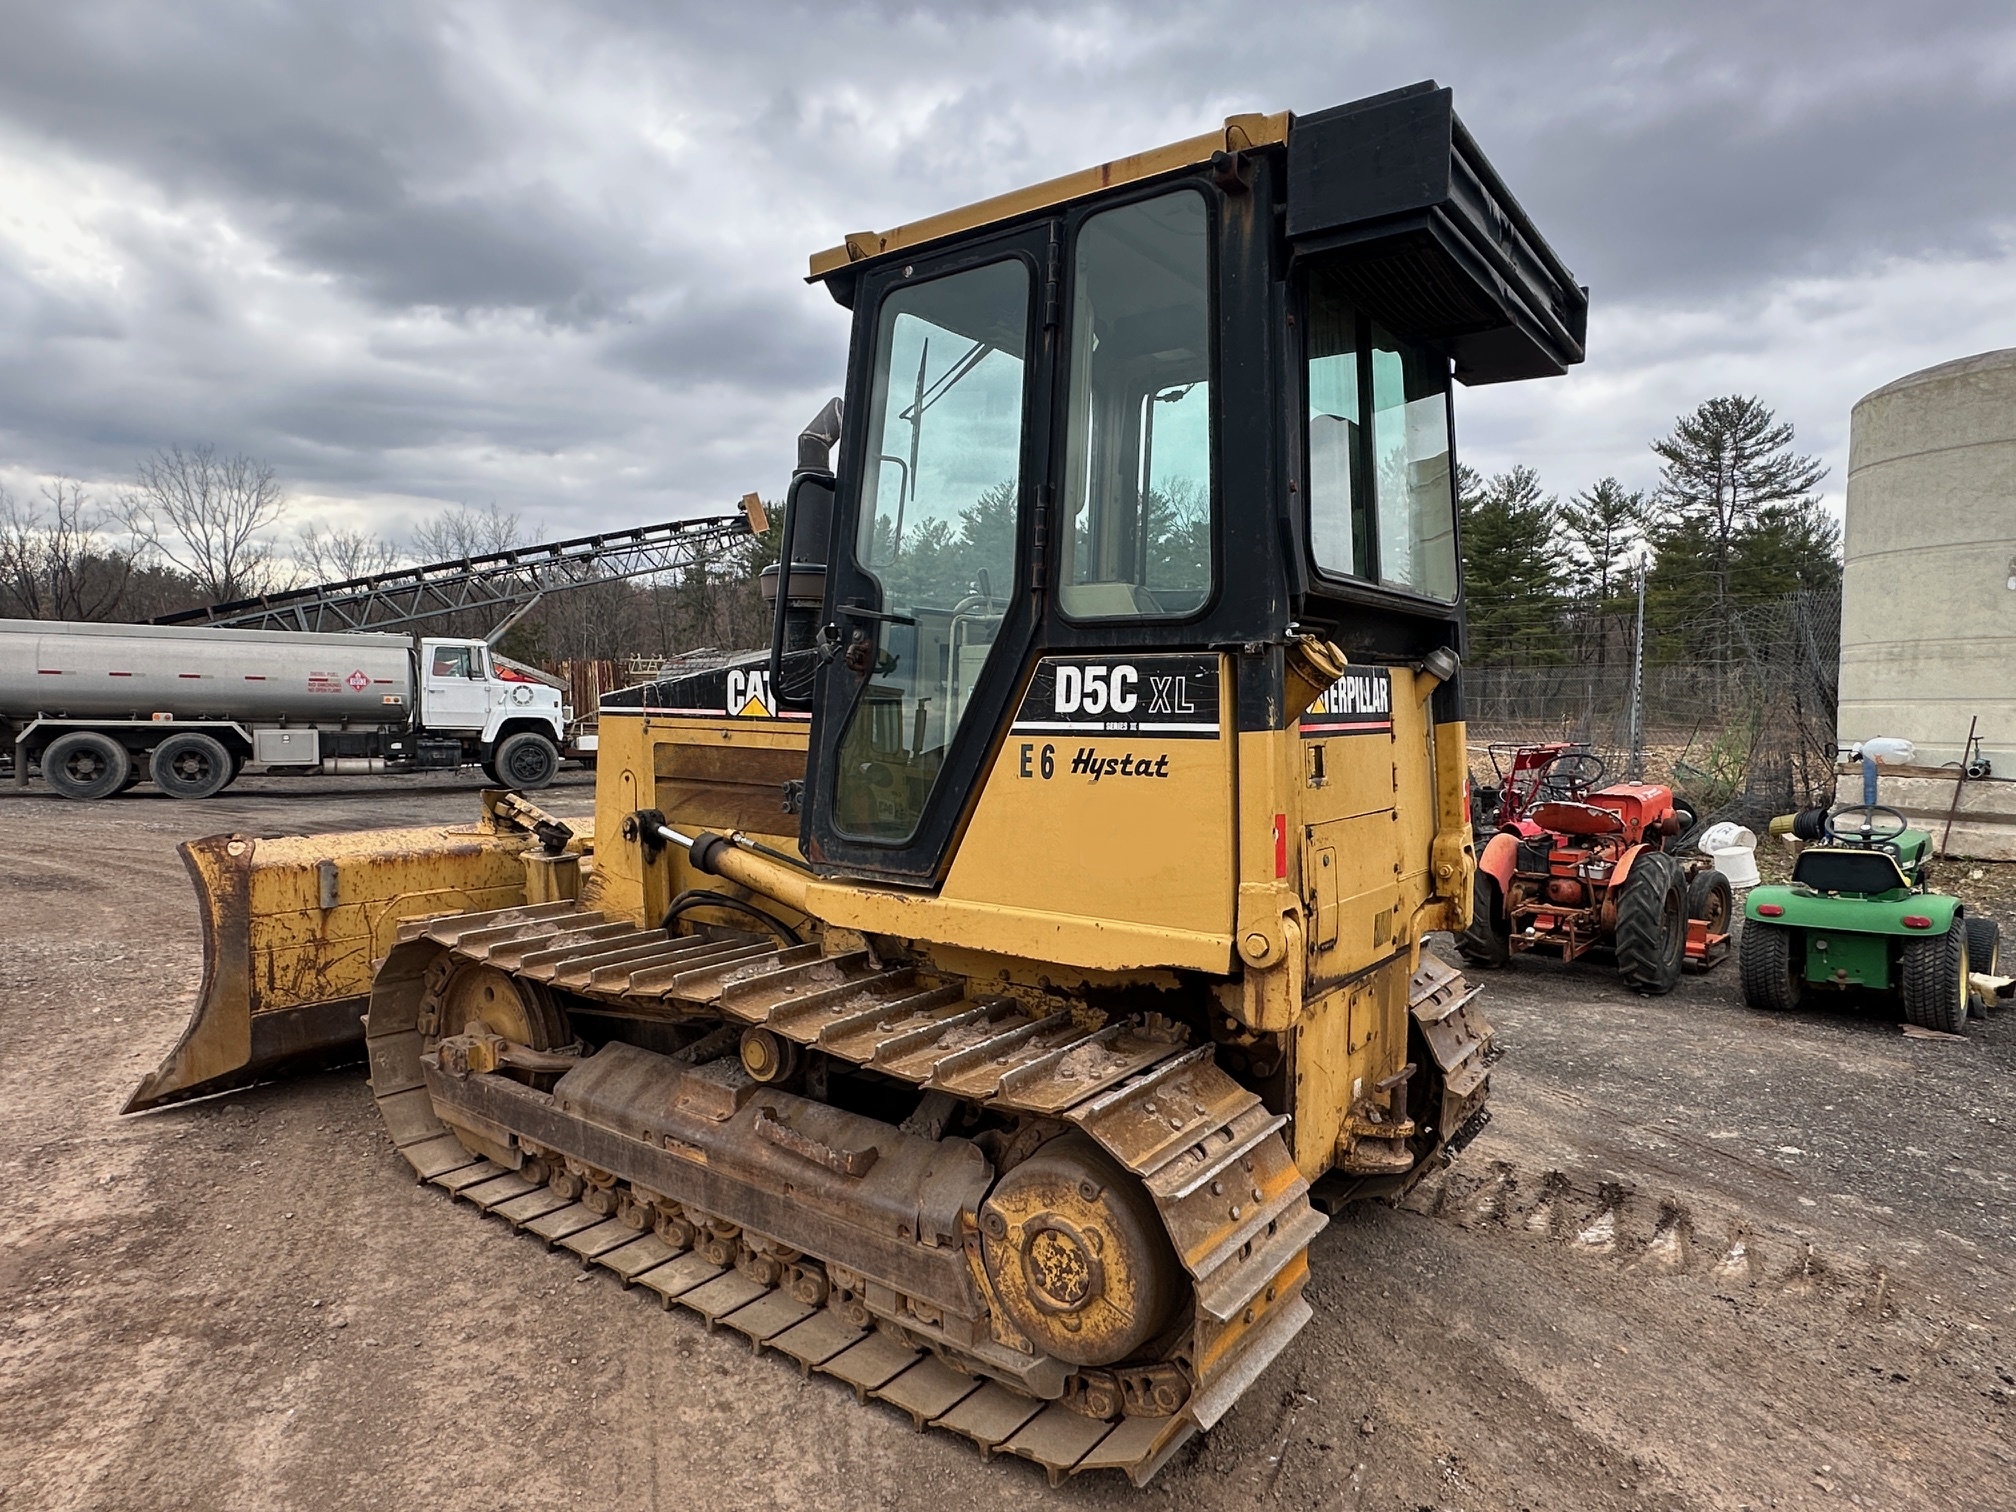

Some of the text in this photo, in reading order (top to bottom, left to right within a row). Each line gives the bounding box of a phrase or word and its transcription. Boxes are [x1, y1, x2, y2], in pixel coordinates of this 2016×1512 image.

[1054, 665, 1194, 714] D5C XL
[1305, 675, 1388, 713] ERPILLAR
[1105, 722, 1128, 731] SERIES
[1071, 748, 1170, 782] Hystat
